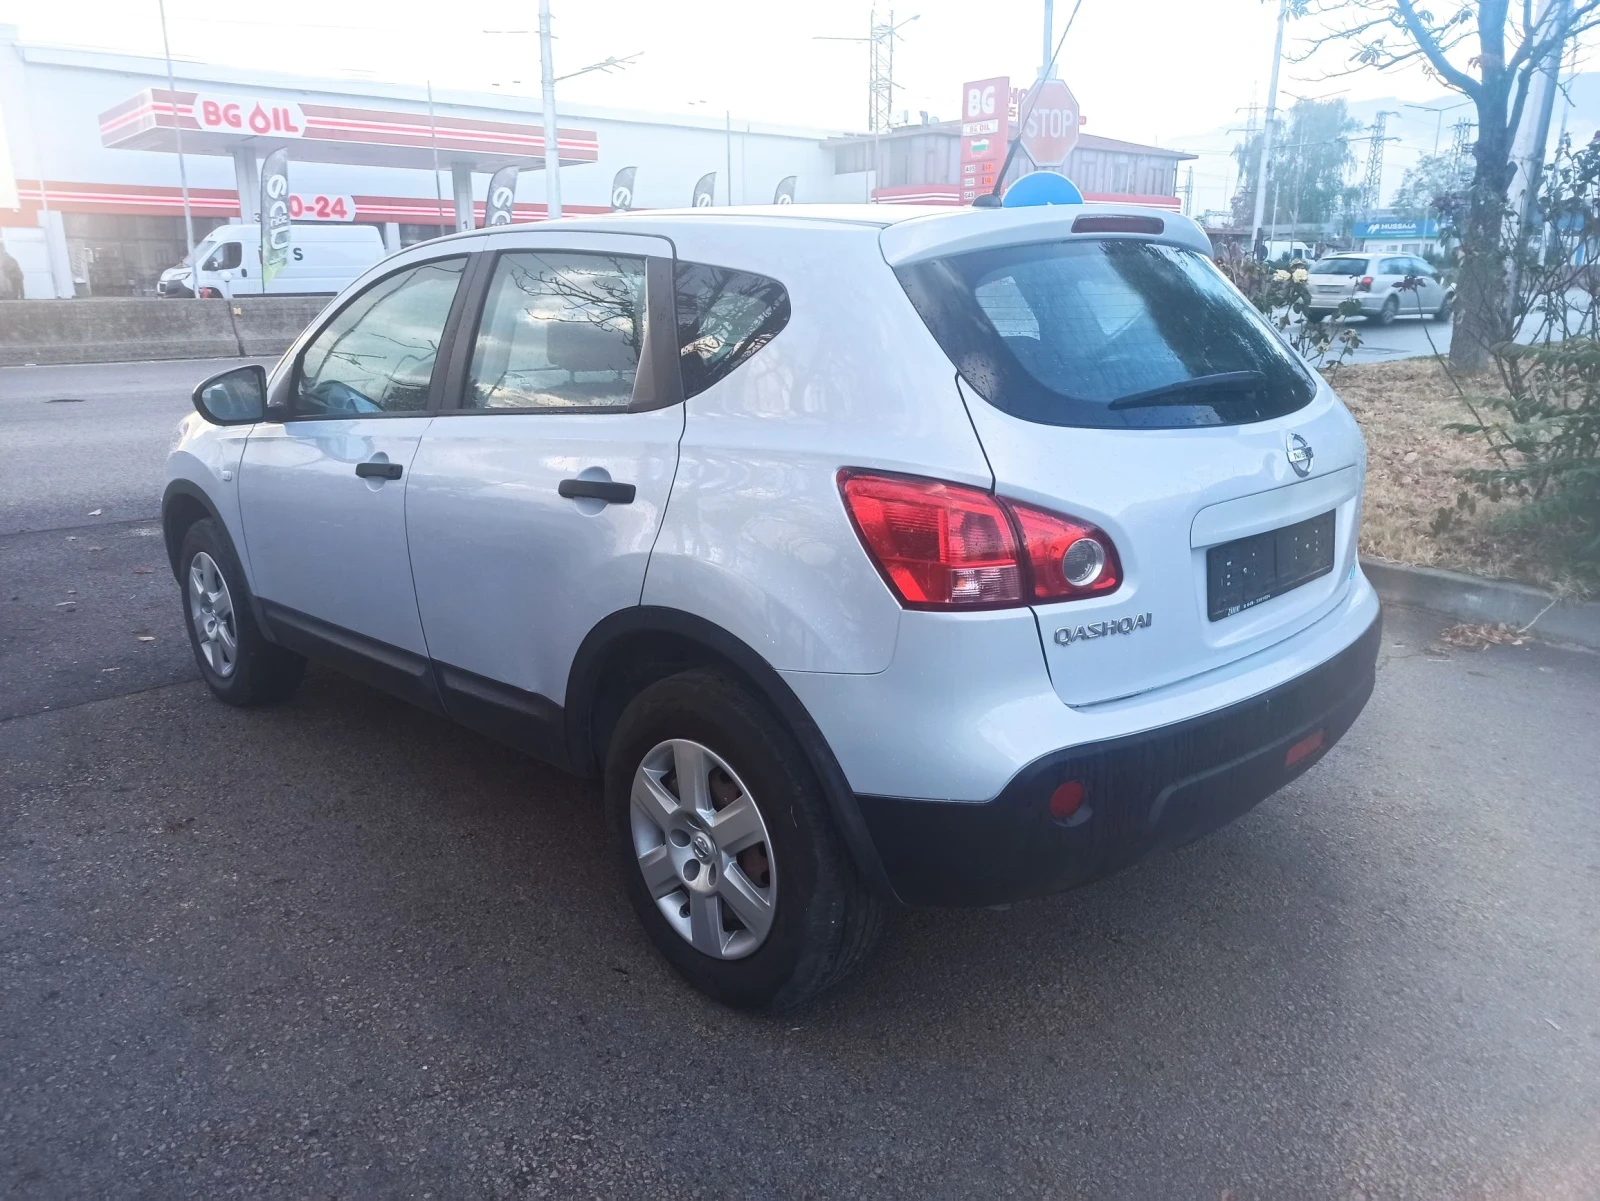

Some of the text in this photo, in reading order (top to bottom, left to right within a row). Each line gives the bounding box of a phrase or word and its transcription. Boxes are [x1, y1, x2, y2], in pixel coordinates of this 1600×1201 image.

[202, 100, 299, 134] BG OIL
[968, 85, 996, 117] BG
[979, 123, 991, 132] OIL
[1026, 109, 1073, 138] STOP
[1054, 611, 1153, 646] QASHQAI
